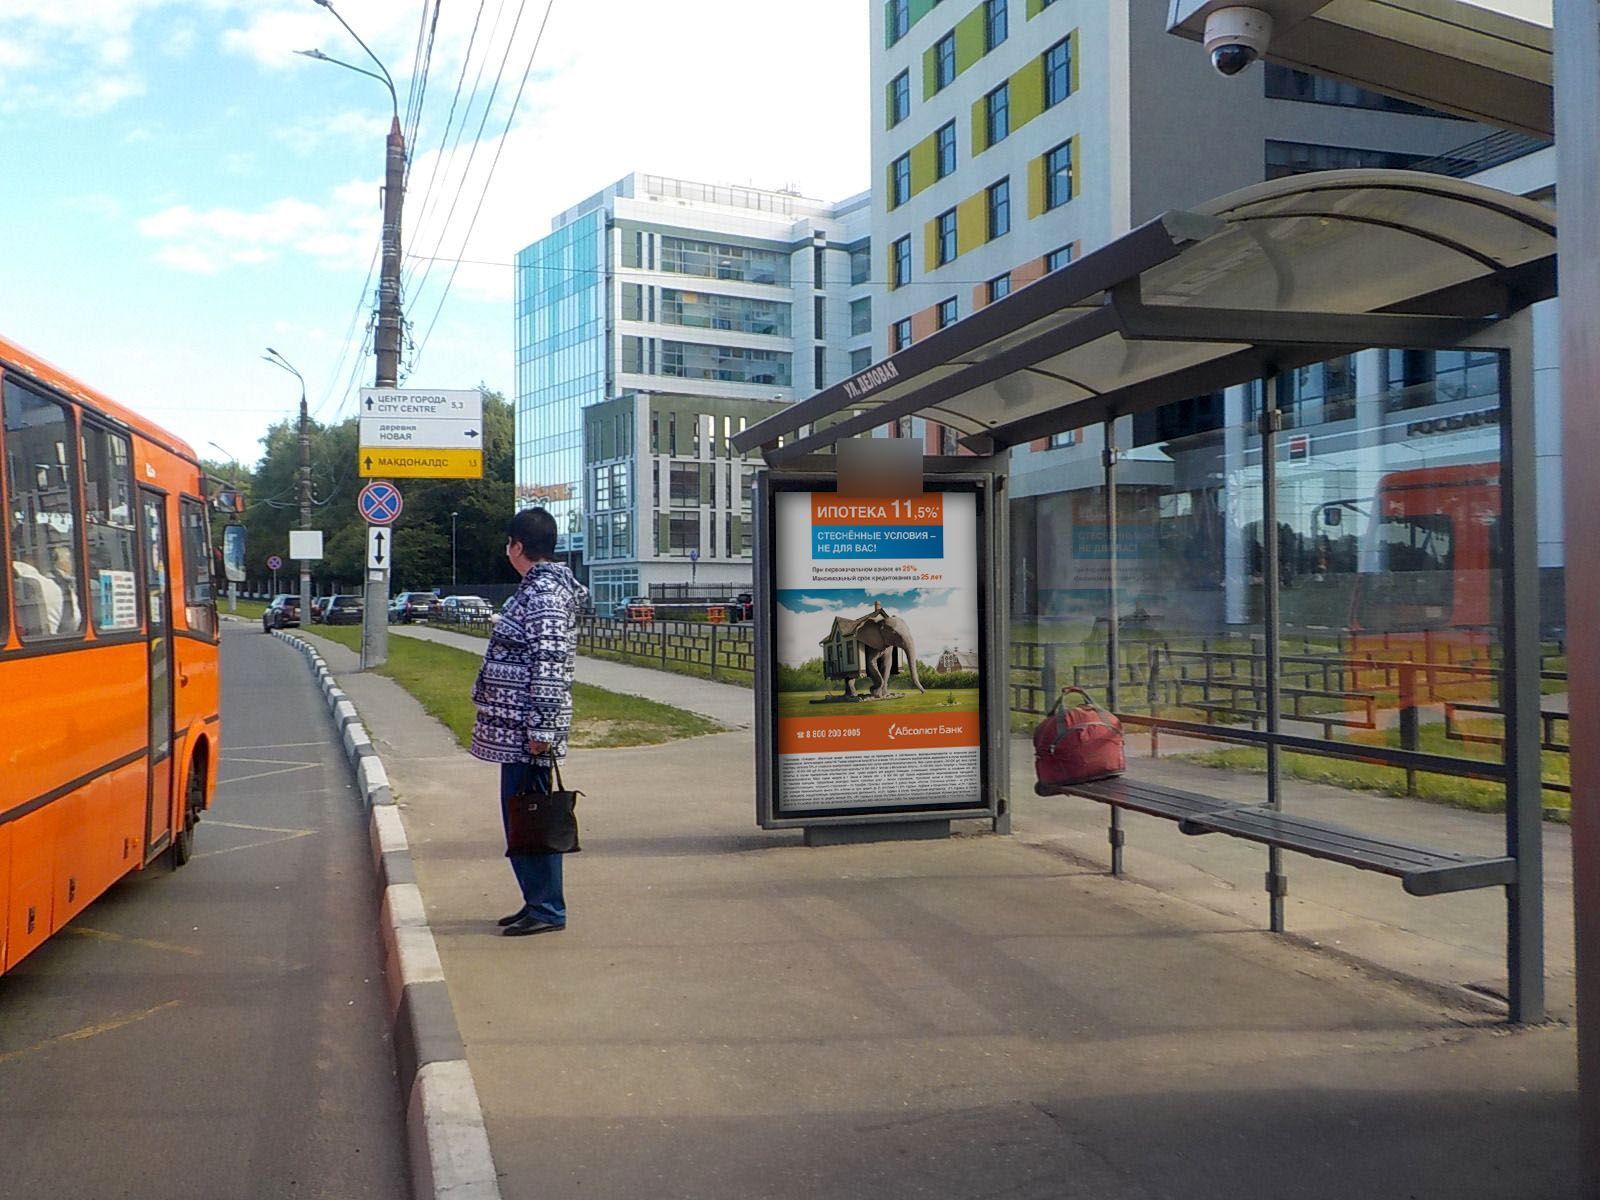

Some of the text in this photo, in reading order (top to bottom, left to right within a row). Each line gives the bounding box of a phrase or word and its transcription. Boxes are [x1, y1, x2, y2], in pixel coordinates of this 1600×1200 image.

[843, 360, 899, 399] УЛ. ДЕЛОВАЯ
[378, 395, 447, 404] ЦЕНТР ГОРОДА
[378, 404, 437, 413] CITY CENTRE
[378, 458, 449, 468] МАКДОНАЛДС
[817, 505, 887, 519] ИПОТЕКА
[817, 530, 881, 540] СТЕСНЁННЫЕ
[884, 531, 929, 540] УСЛОВИЯ
[817, 544, 877, 554] НЕ ДЛЯ ВАС!
[895, 725, 963, 736] Абсолют Банк
